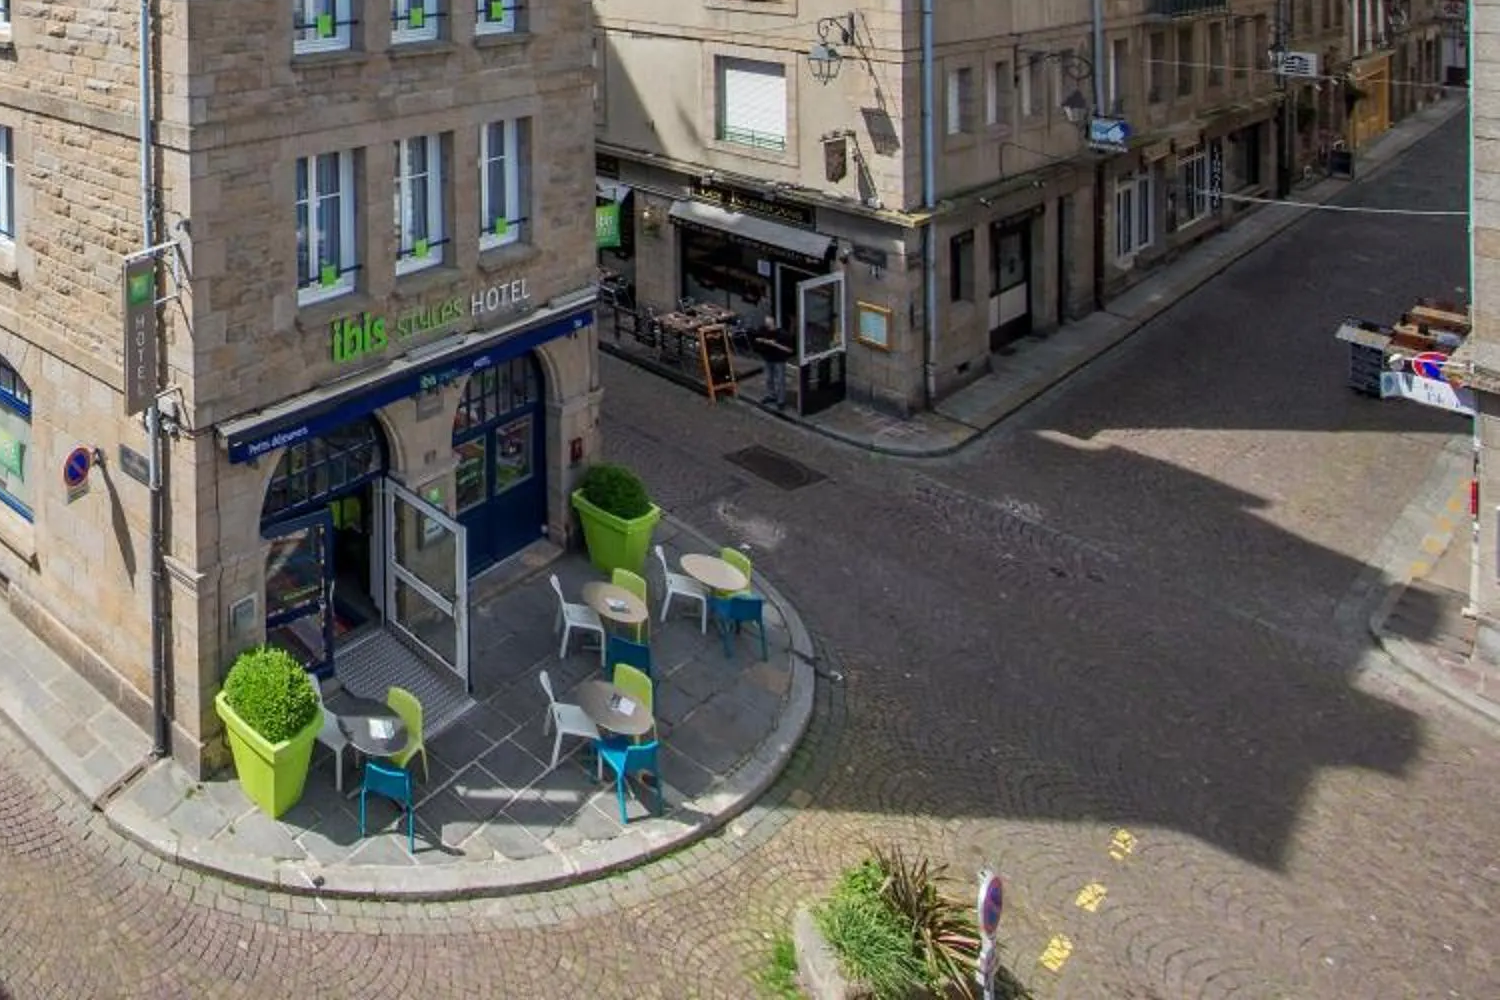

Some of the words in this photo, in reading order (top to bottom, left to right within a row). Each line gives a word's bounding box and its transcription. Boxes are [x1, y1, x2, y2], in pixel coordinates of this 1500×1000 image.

[135, 314, 147, 396] HOTEL
[331, 311, 388, 363] ibis
[471, 279, 530, 316] HOTEL
